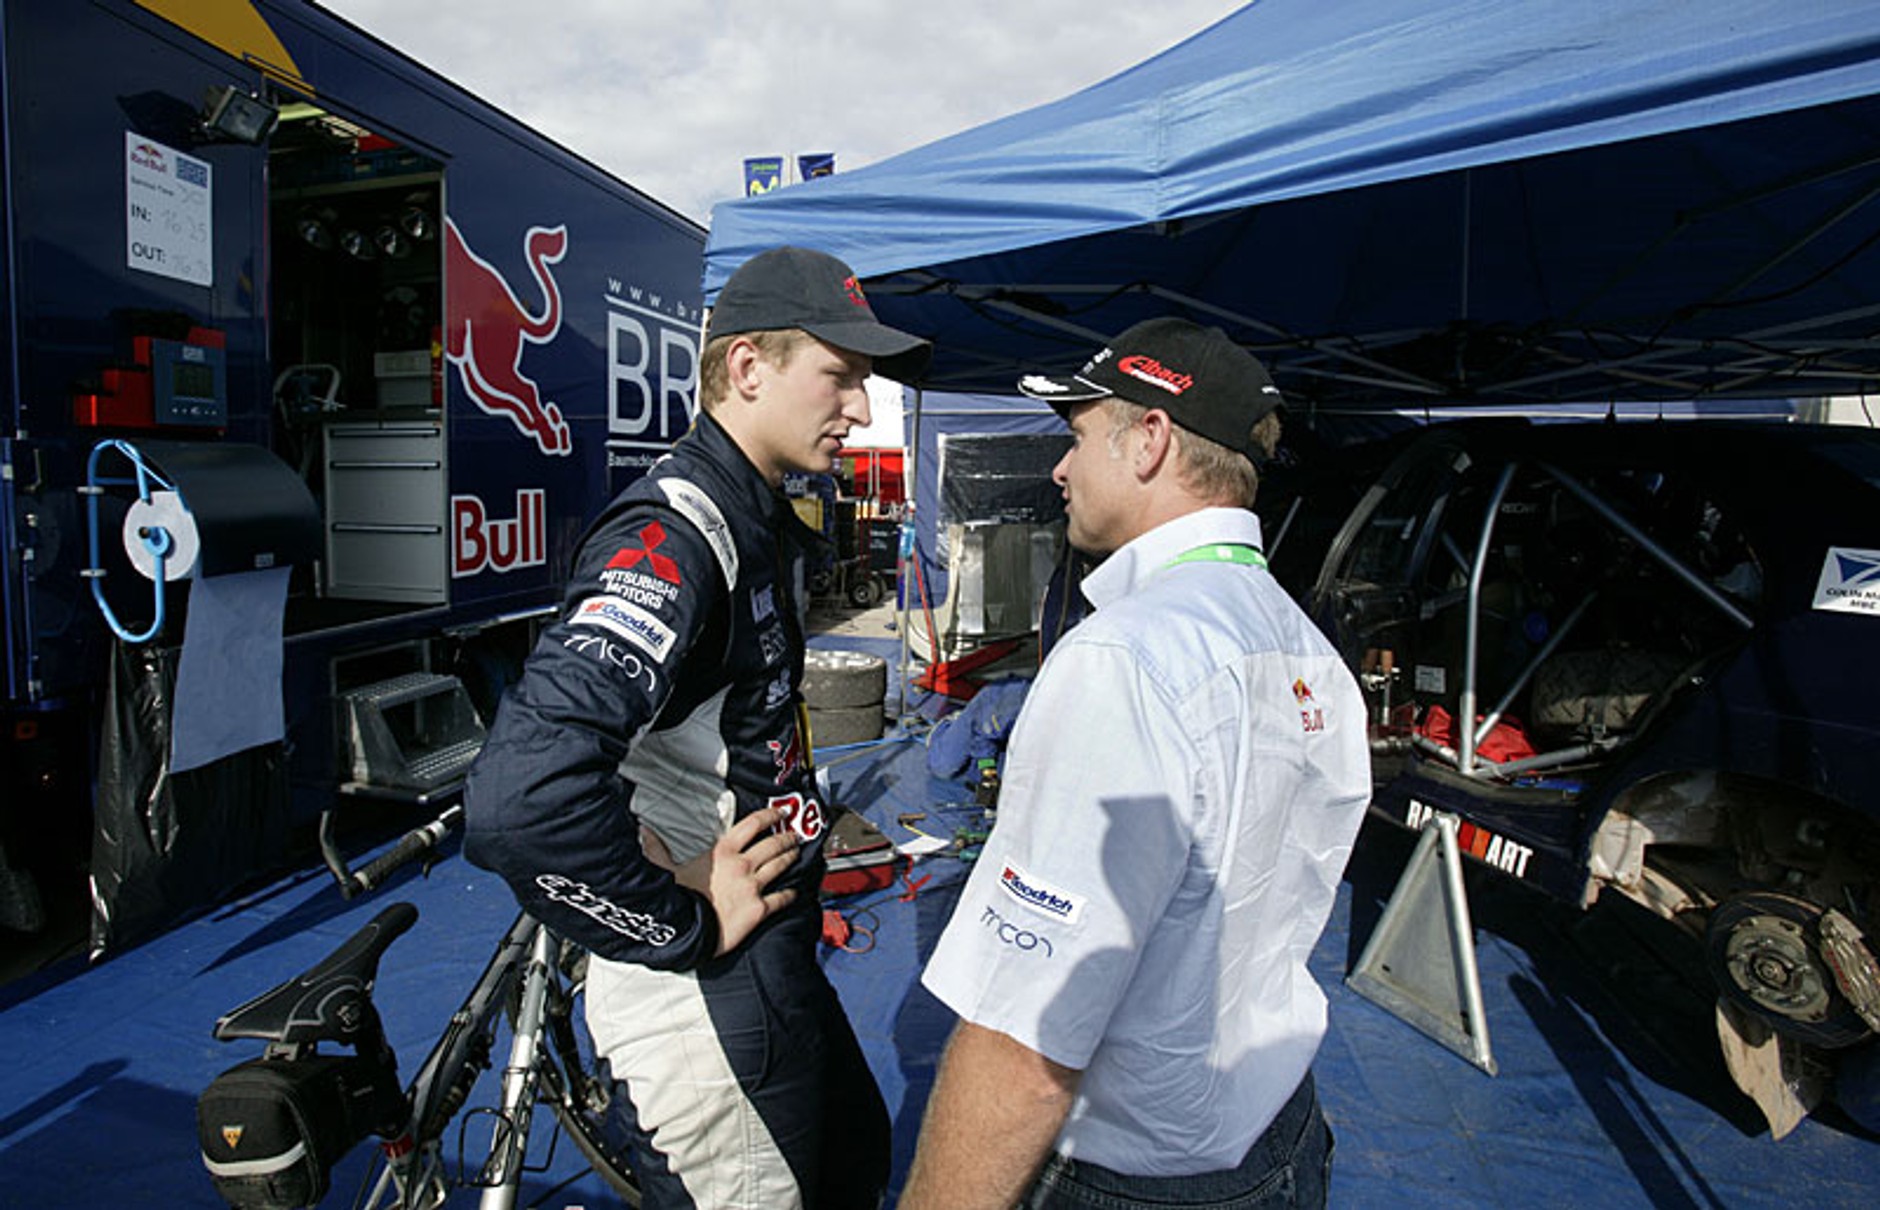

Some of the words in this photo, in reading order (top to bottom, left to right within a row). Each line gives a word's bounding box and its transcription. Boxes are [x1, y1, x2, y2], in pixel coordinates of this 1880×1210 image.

[130, 152, 149, 168] Red
[149, 158, 168, 173] Bull
[131, 203, 152, 222] IN:
[131, 241, 167, 265] OUT:
[452, 489, 546, 578] Bull
[600, 569, 679, 602] MITSUBISHI
[604, 582, 664, 610] MOTORS
[768, 793, 826, 842] Re
